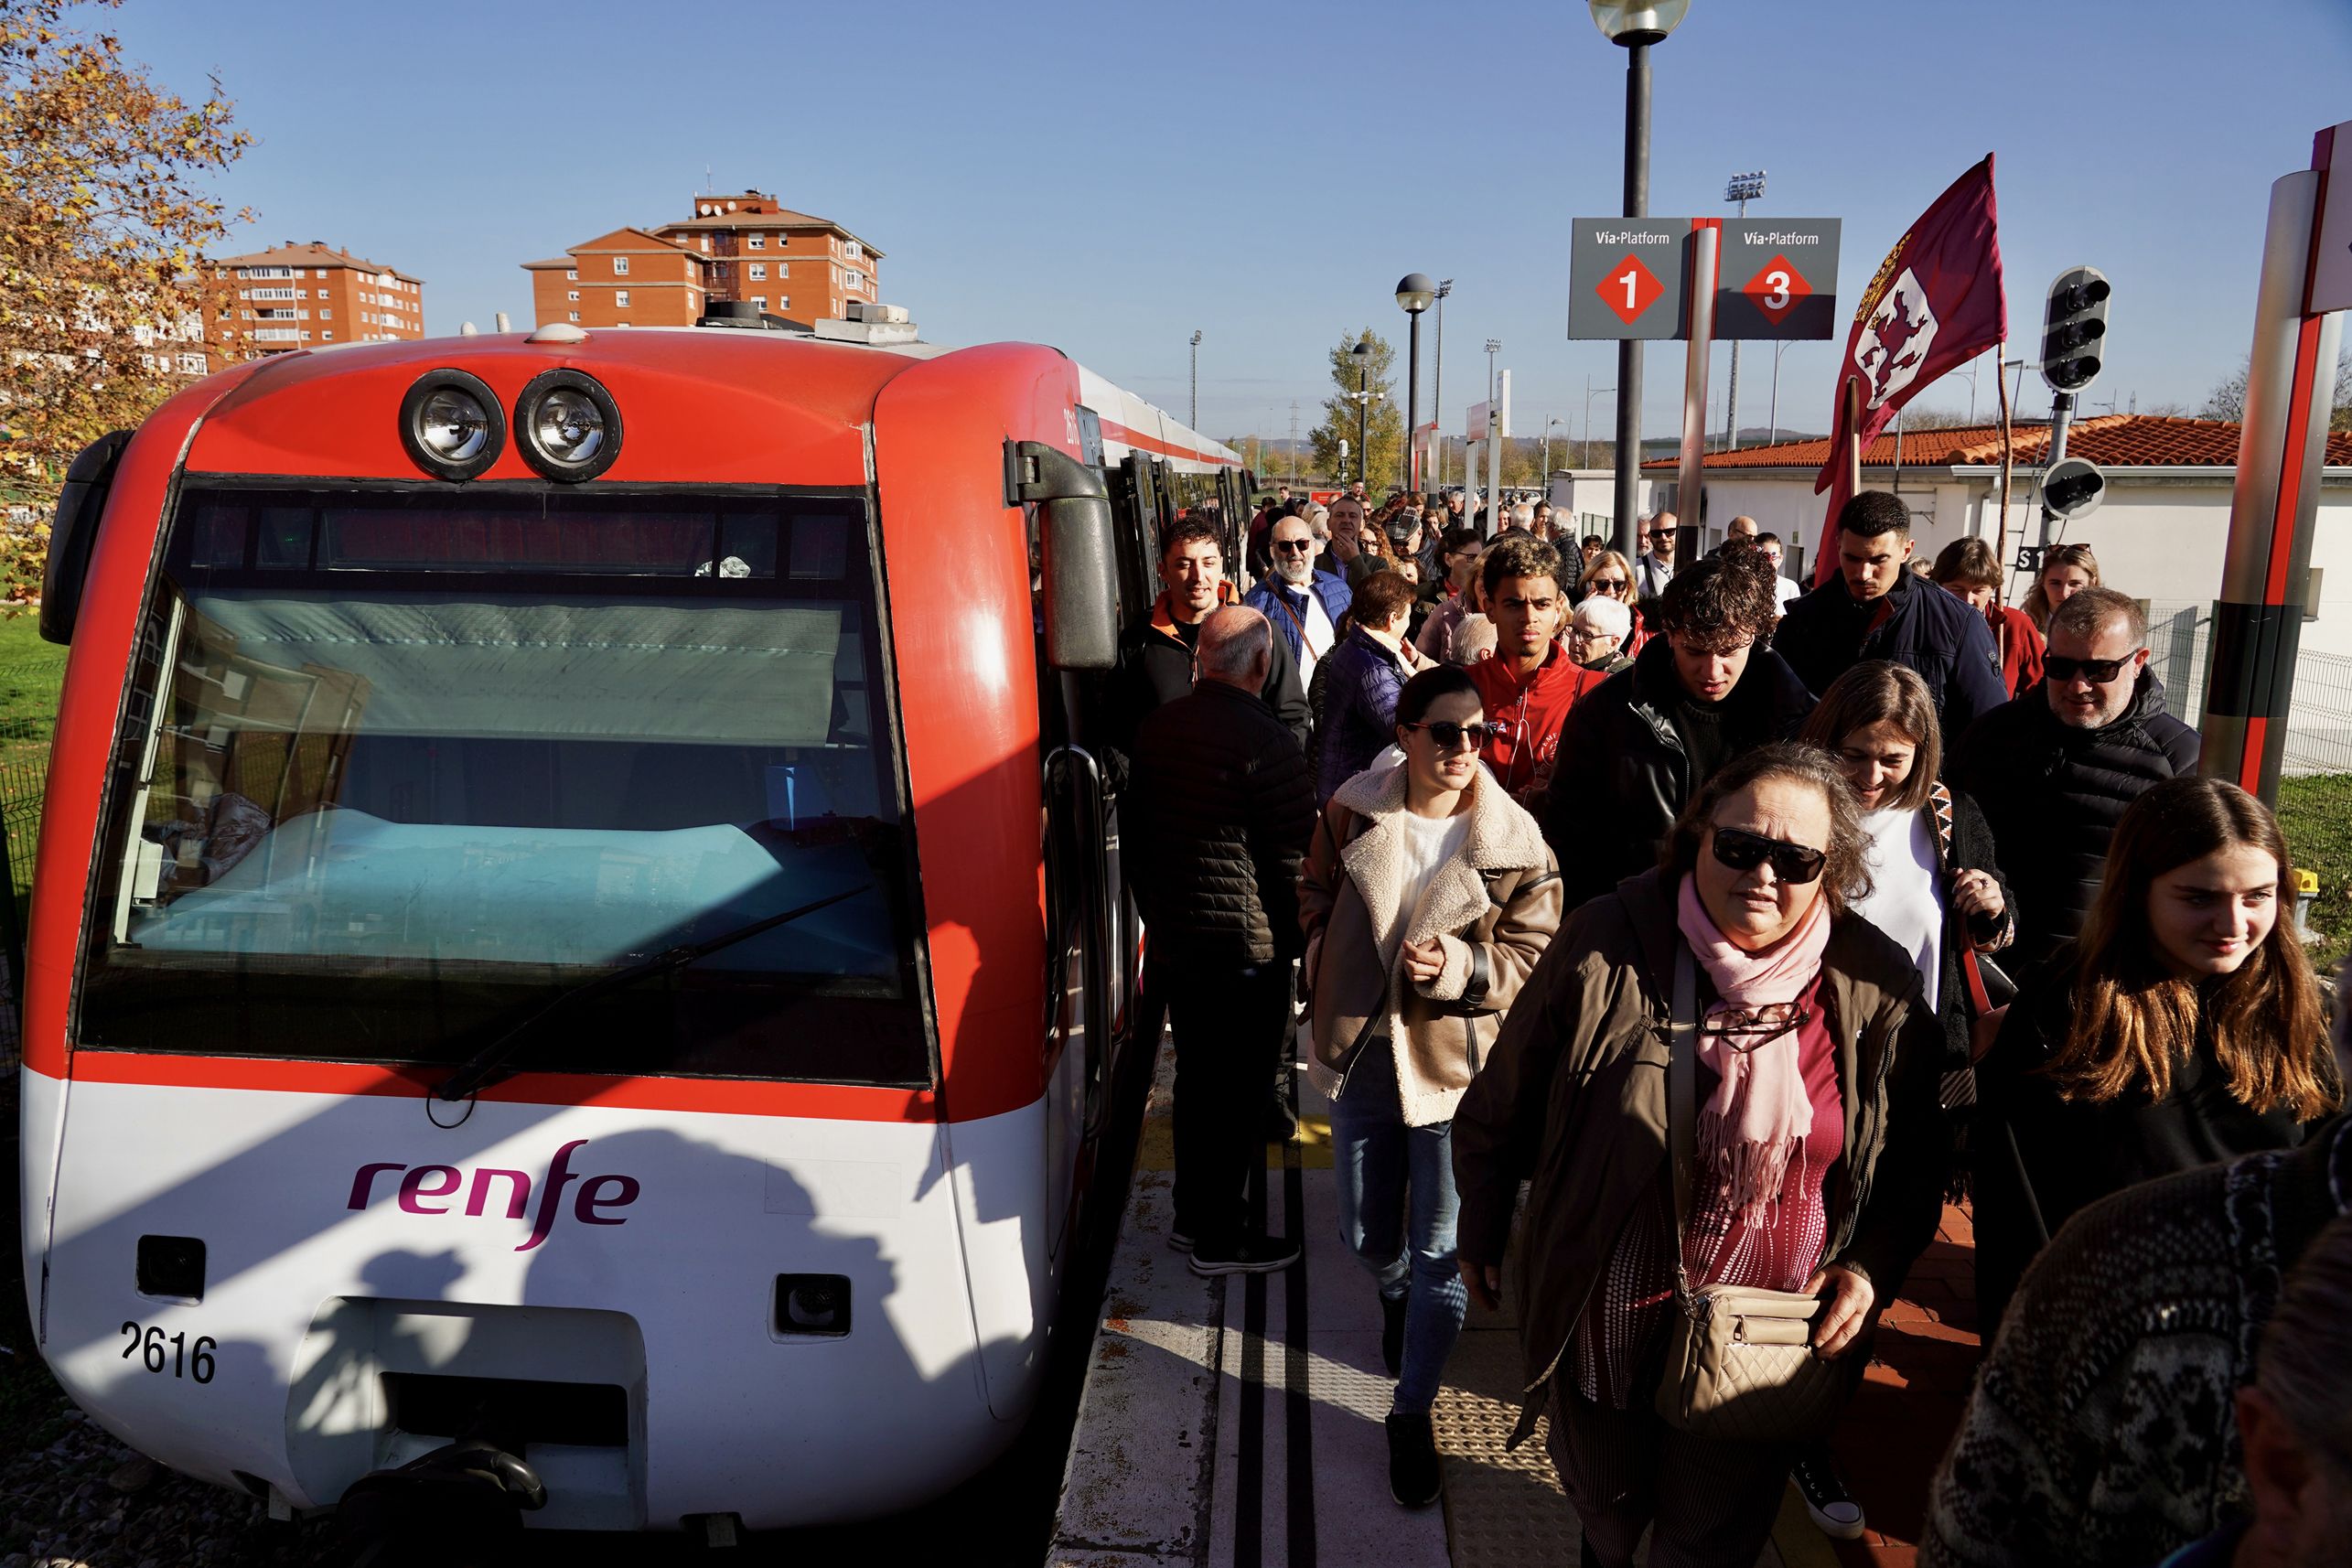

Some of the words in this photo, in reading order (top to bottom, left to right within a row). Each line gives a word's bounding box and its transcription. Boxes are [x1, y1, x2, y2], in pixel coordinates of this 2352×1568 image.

[1619, 270, 1637, 309] 1
[1764, 271, 1790, 310] 3
[347, 1139, 641, 1251] renfe
[121, 1320, 217, 1385] 2616
